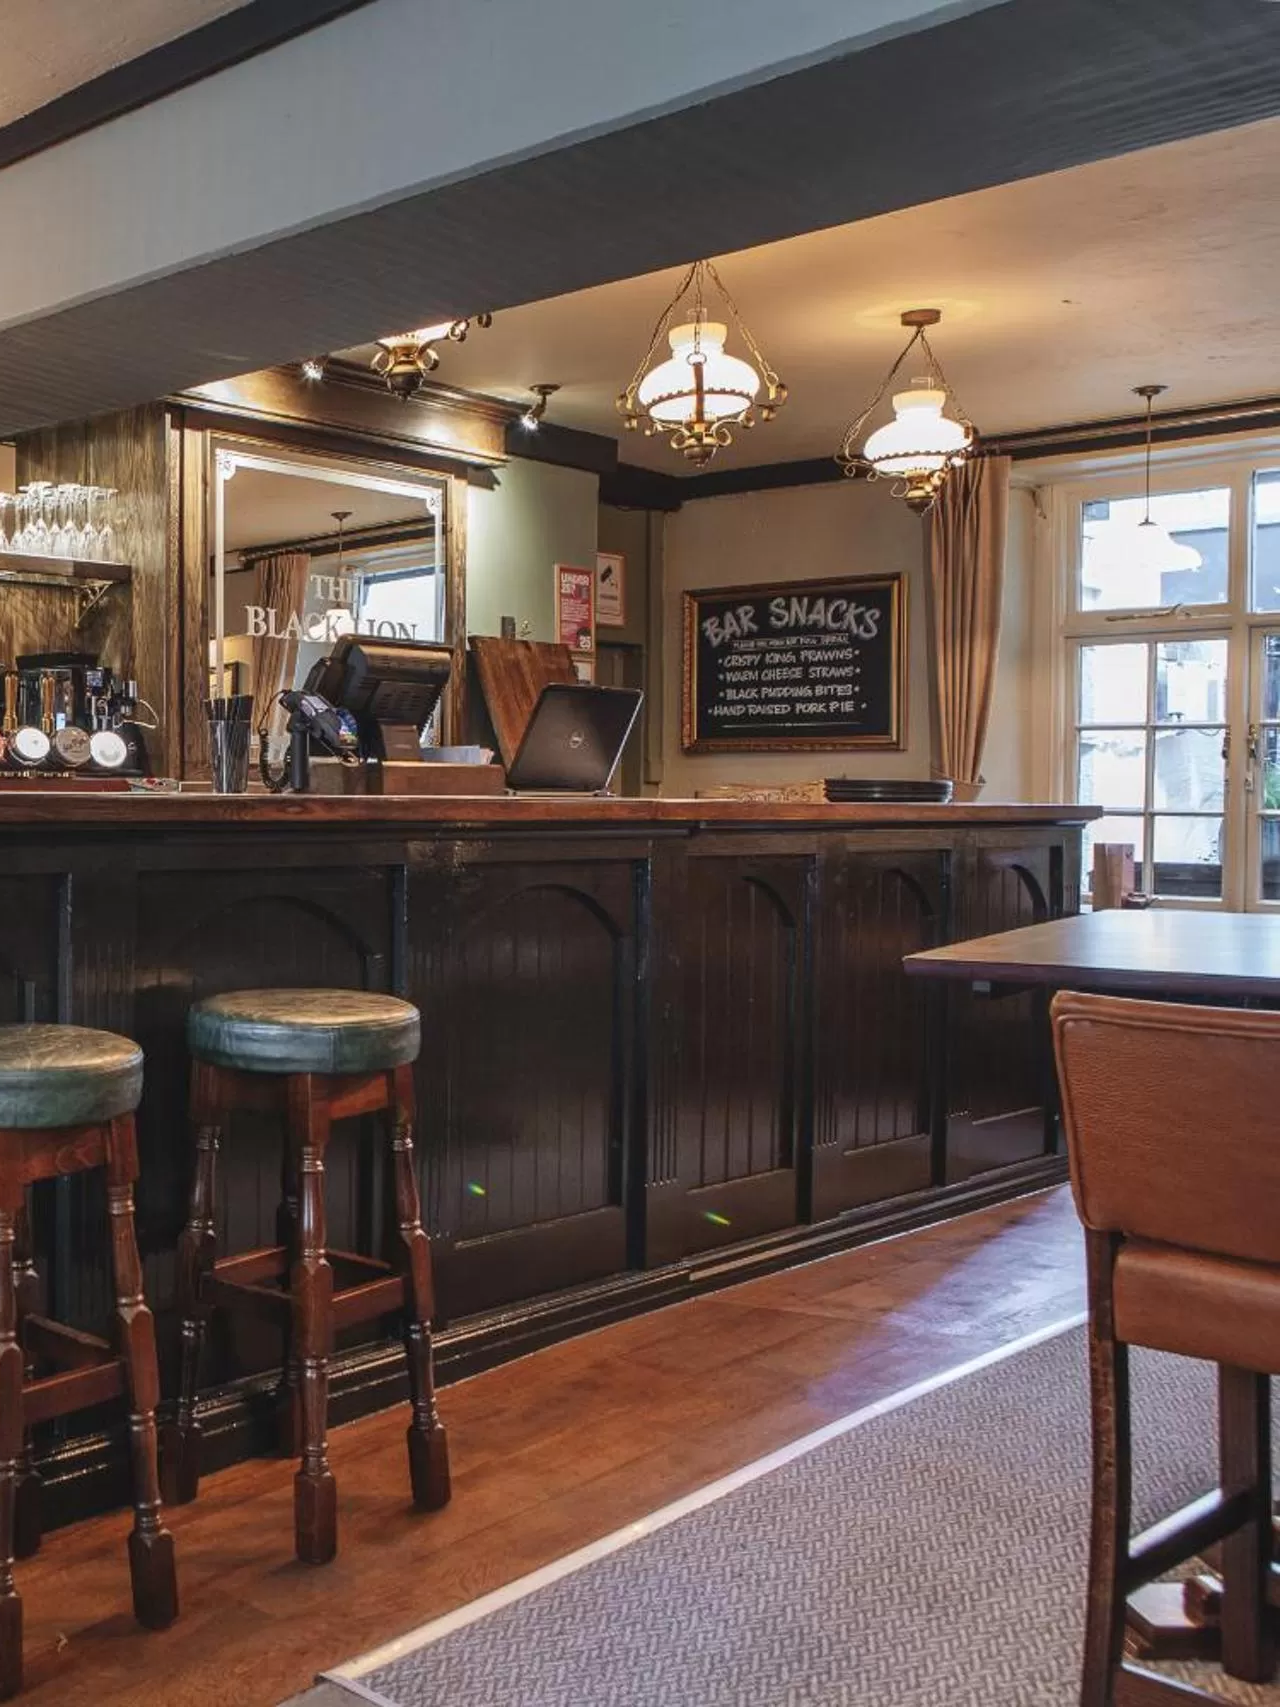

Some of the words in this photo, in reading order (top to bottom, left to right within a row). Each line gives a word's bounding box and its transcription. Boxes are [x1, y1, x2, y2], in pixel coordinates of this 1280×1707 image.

[244, 604, 344, 642] BLACK
[702, 605, 759, 648] BAR
[770, 597, 882, 641] SNACKS
[765, 651, 797, 665] KING
[800, 648, 853, 663] PRAWNS
[809, 665, 854, 679] STRAWS
[726, 687, 758, 700] BLACK
[761, 686, 813, 699] PUDDING
[815, 684, 853, 697] BITES
[713, 704, 746, 717] HAND
[747, 703, 791, 715] RAISED
[795, 702, 827, 714] PORK
[829, 700, 855, 713] PIE
